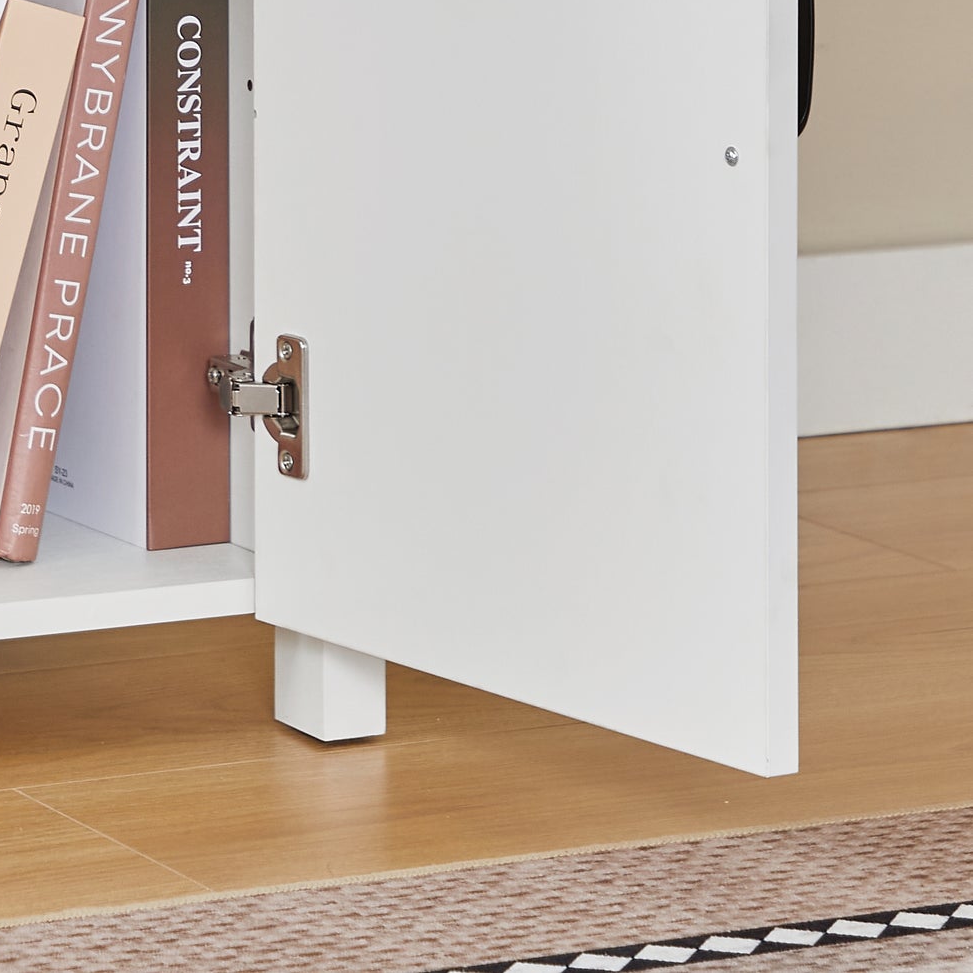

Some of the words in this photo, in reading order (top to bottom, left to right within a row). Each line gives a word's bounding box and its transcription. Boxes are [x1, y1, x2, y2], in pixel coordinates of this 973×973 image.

[59, 0, 130, 258] WYBRANE
[176, 15, 202, 252] CONSTRAINT
[27, 278, 80, 452] PRACE
[11, 523, 40, 538] Spring
[20, 503, 41, 515] 2019
